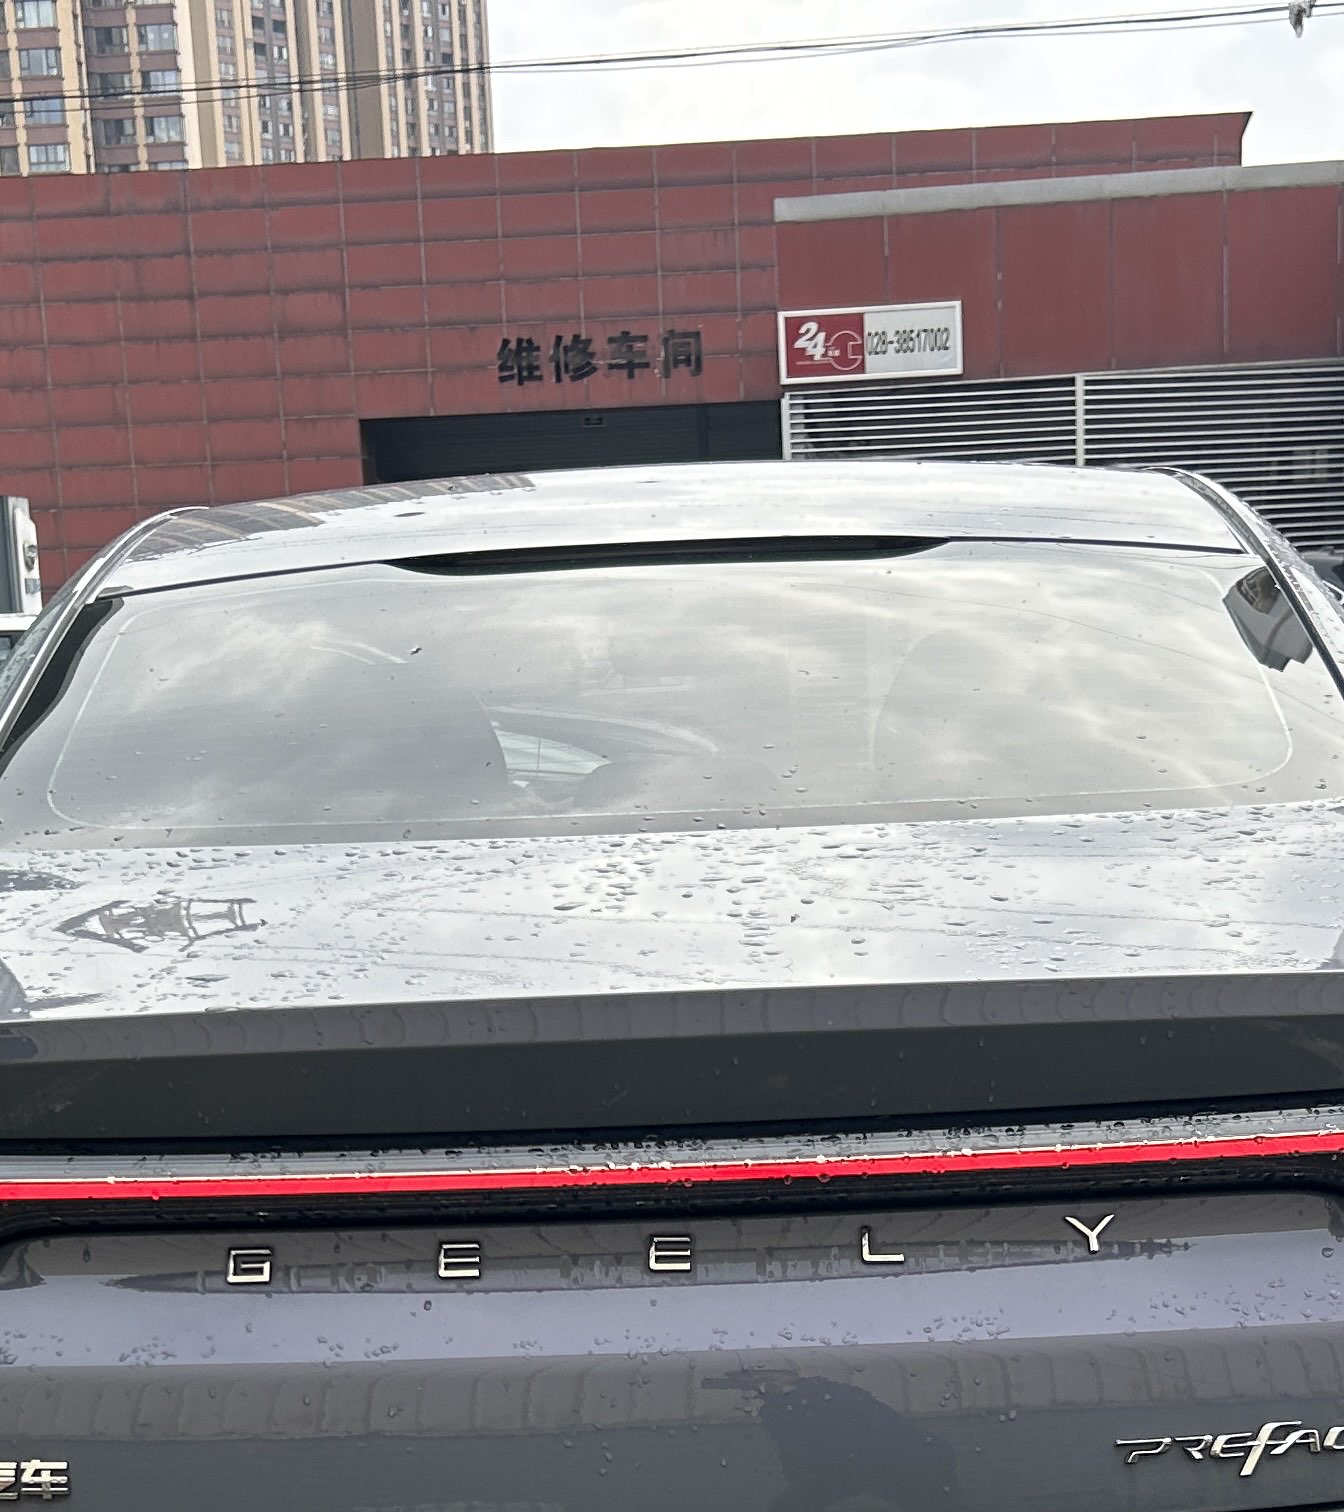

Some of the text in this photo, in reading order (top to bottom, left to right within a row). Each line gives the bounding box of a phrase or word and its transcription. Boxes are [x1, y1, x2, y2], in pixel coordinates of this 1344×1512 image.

[497, 330, 703, 386] 维修车间
[866, 327, 951, 356] 028-38517002
[225, 1213, 1116, 1285] GEELY
